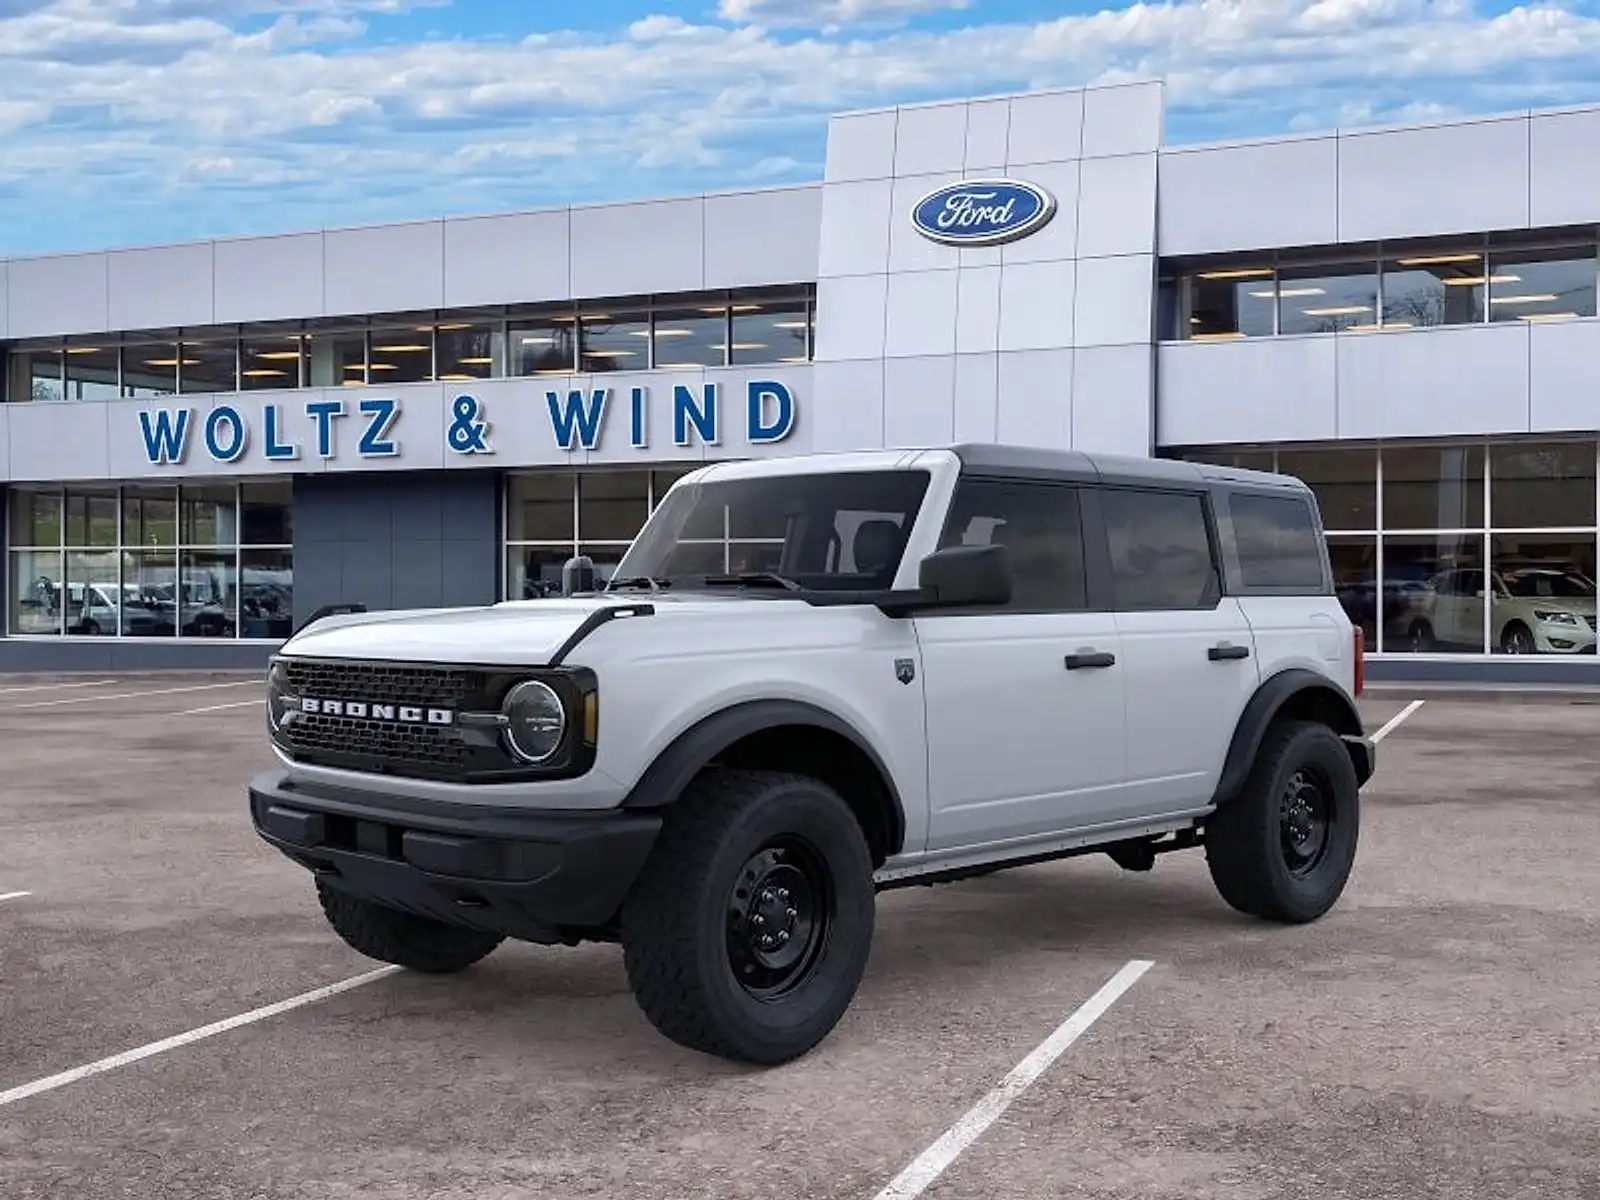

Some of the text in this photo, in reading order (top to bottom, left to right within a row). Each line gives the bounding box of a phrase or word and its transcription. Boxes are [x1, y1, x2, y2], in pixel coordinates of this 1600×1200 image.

[937, 192, 1016, 229] Ford
[138, 380, 795, 464] WOLTZ & WIND
[301, 697, 453, 724] BRONCO
